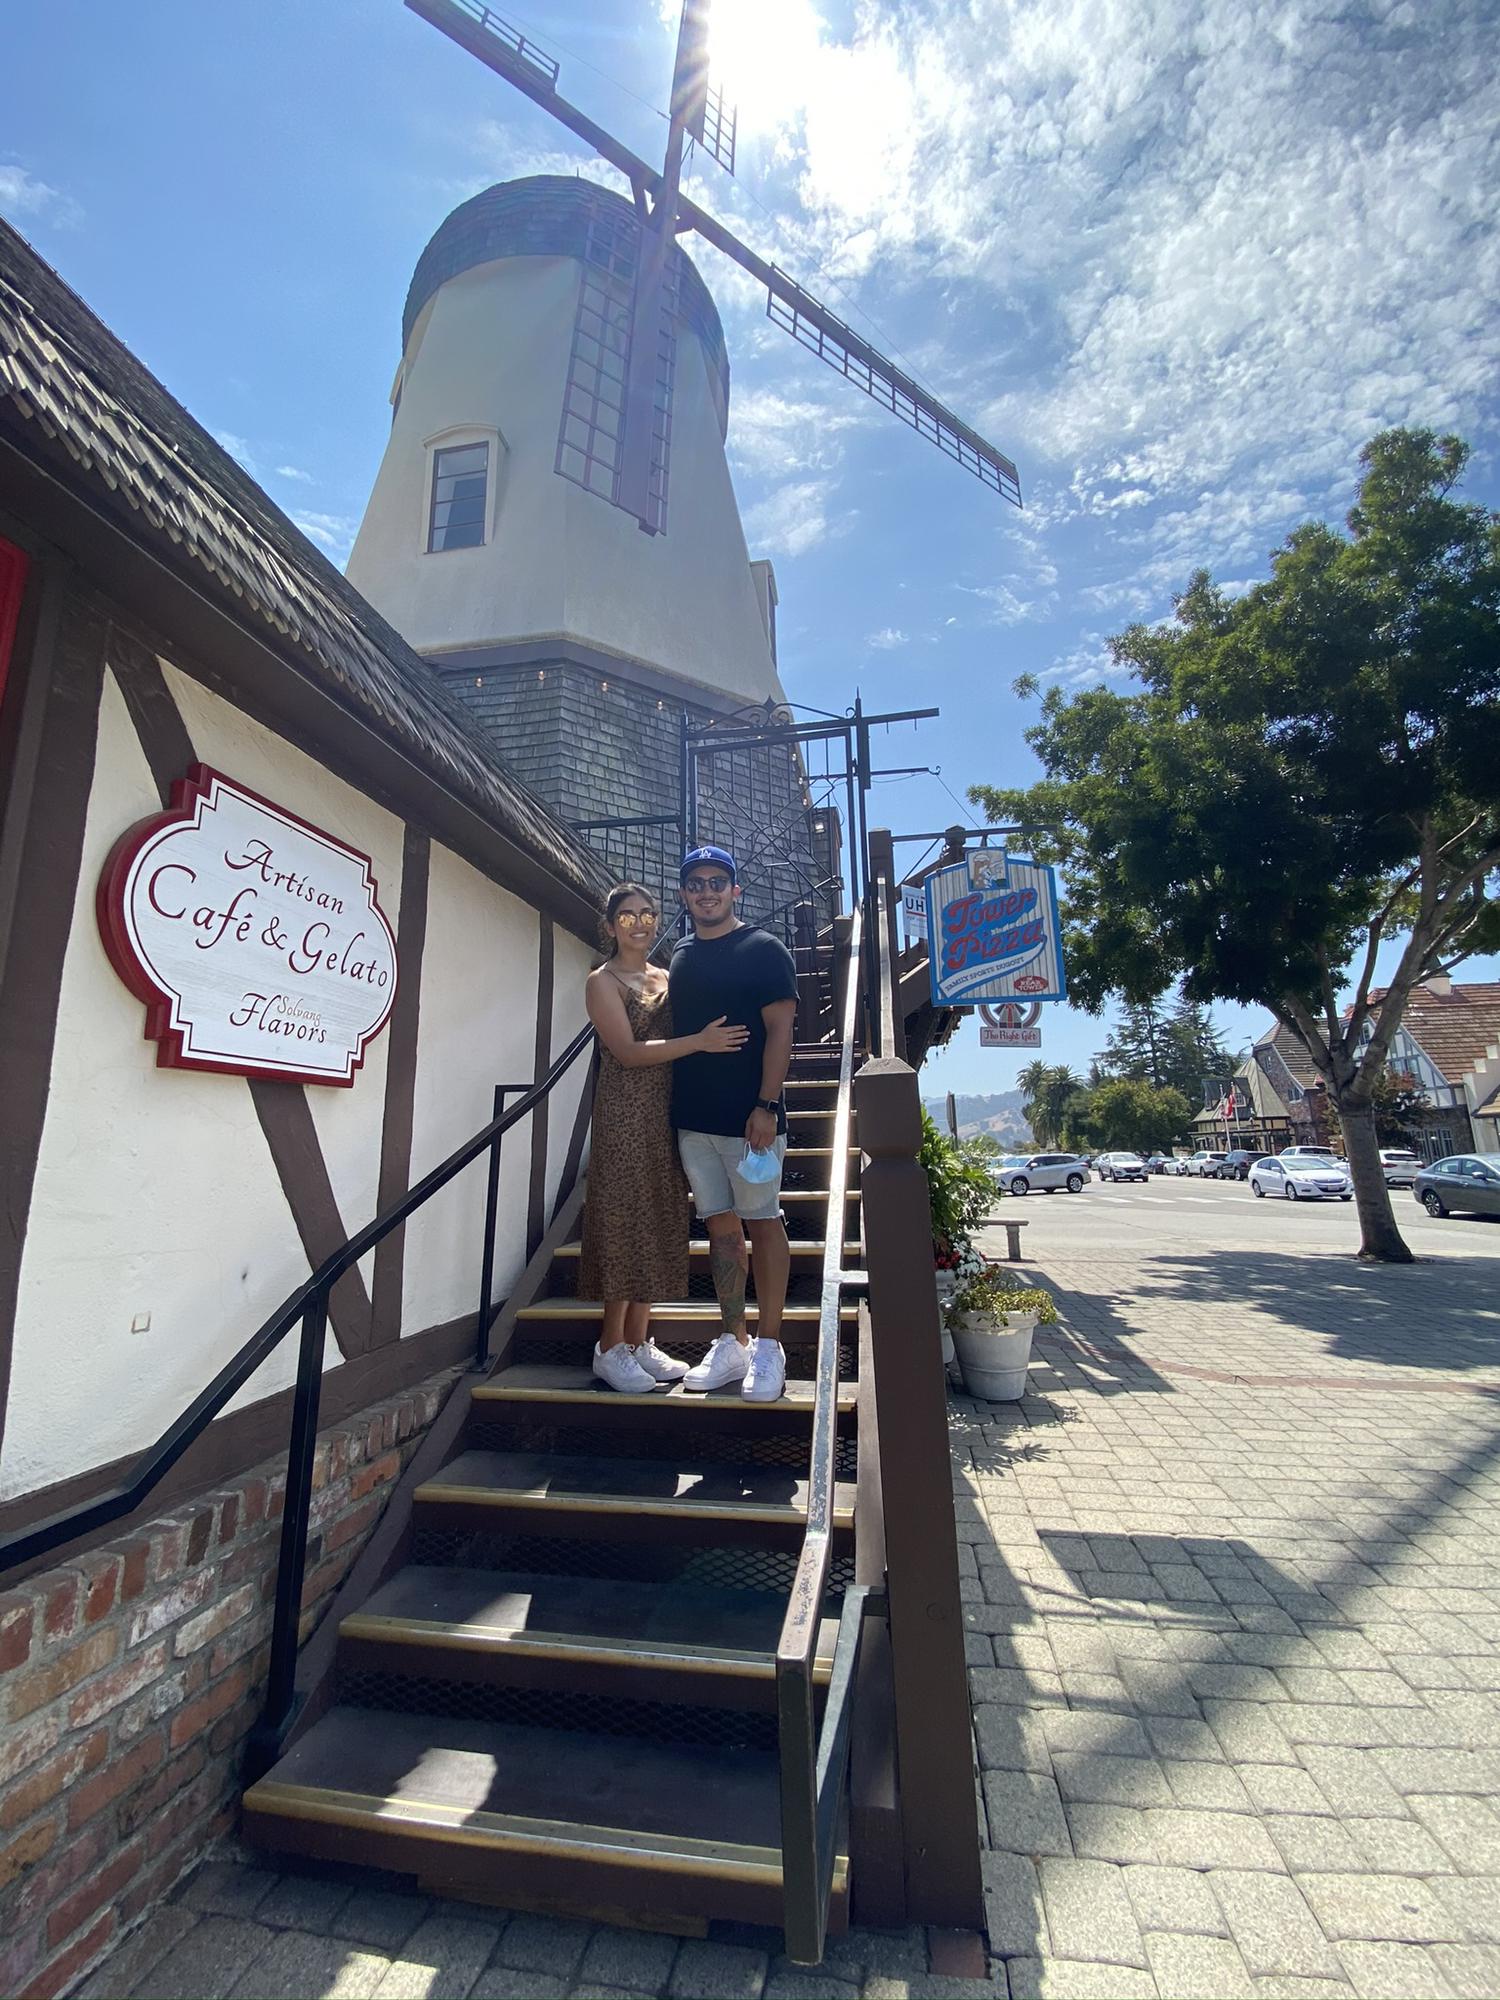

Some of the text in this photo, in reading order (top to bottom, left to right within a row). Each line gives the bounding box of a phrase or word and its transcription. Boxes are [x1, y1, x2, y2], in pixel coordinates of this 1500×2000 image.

[699, 848, 711, 858] LA
[224, 839, 344, 915] Artisan
[148, 864, 388, 988] Café & Gelato
[948, 891, 1033, 934] Tower
[947, 921, 1042, 970] Pizza
[945, 956, 1024, 991] FAMILY SPORTS DUGOUT
[229, 993, 327, 1044] Flavors
[277, 995, 321, 1027] Solvang
[1000, 1030, 1020, 1041] Right
